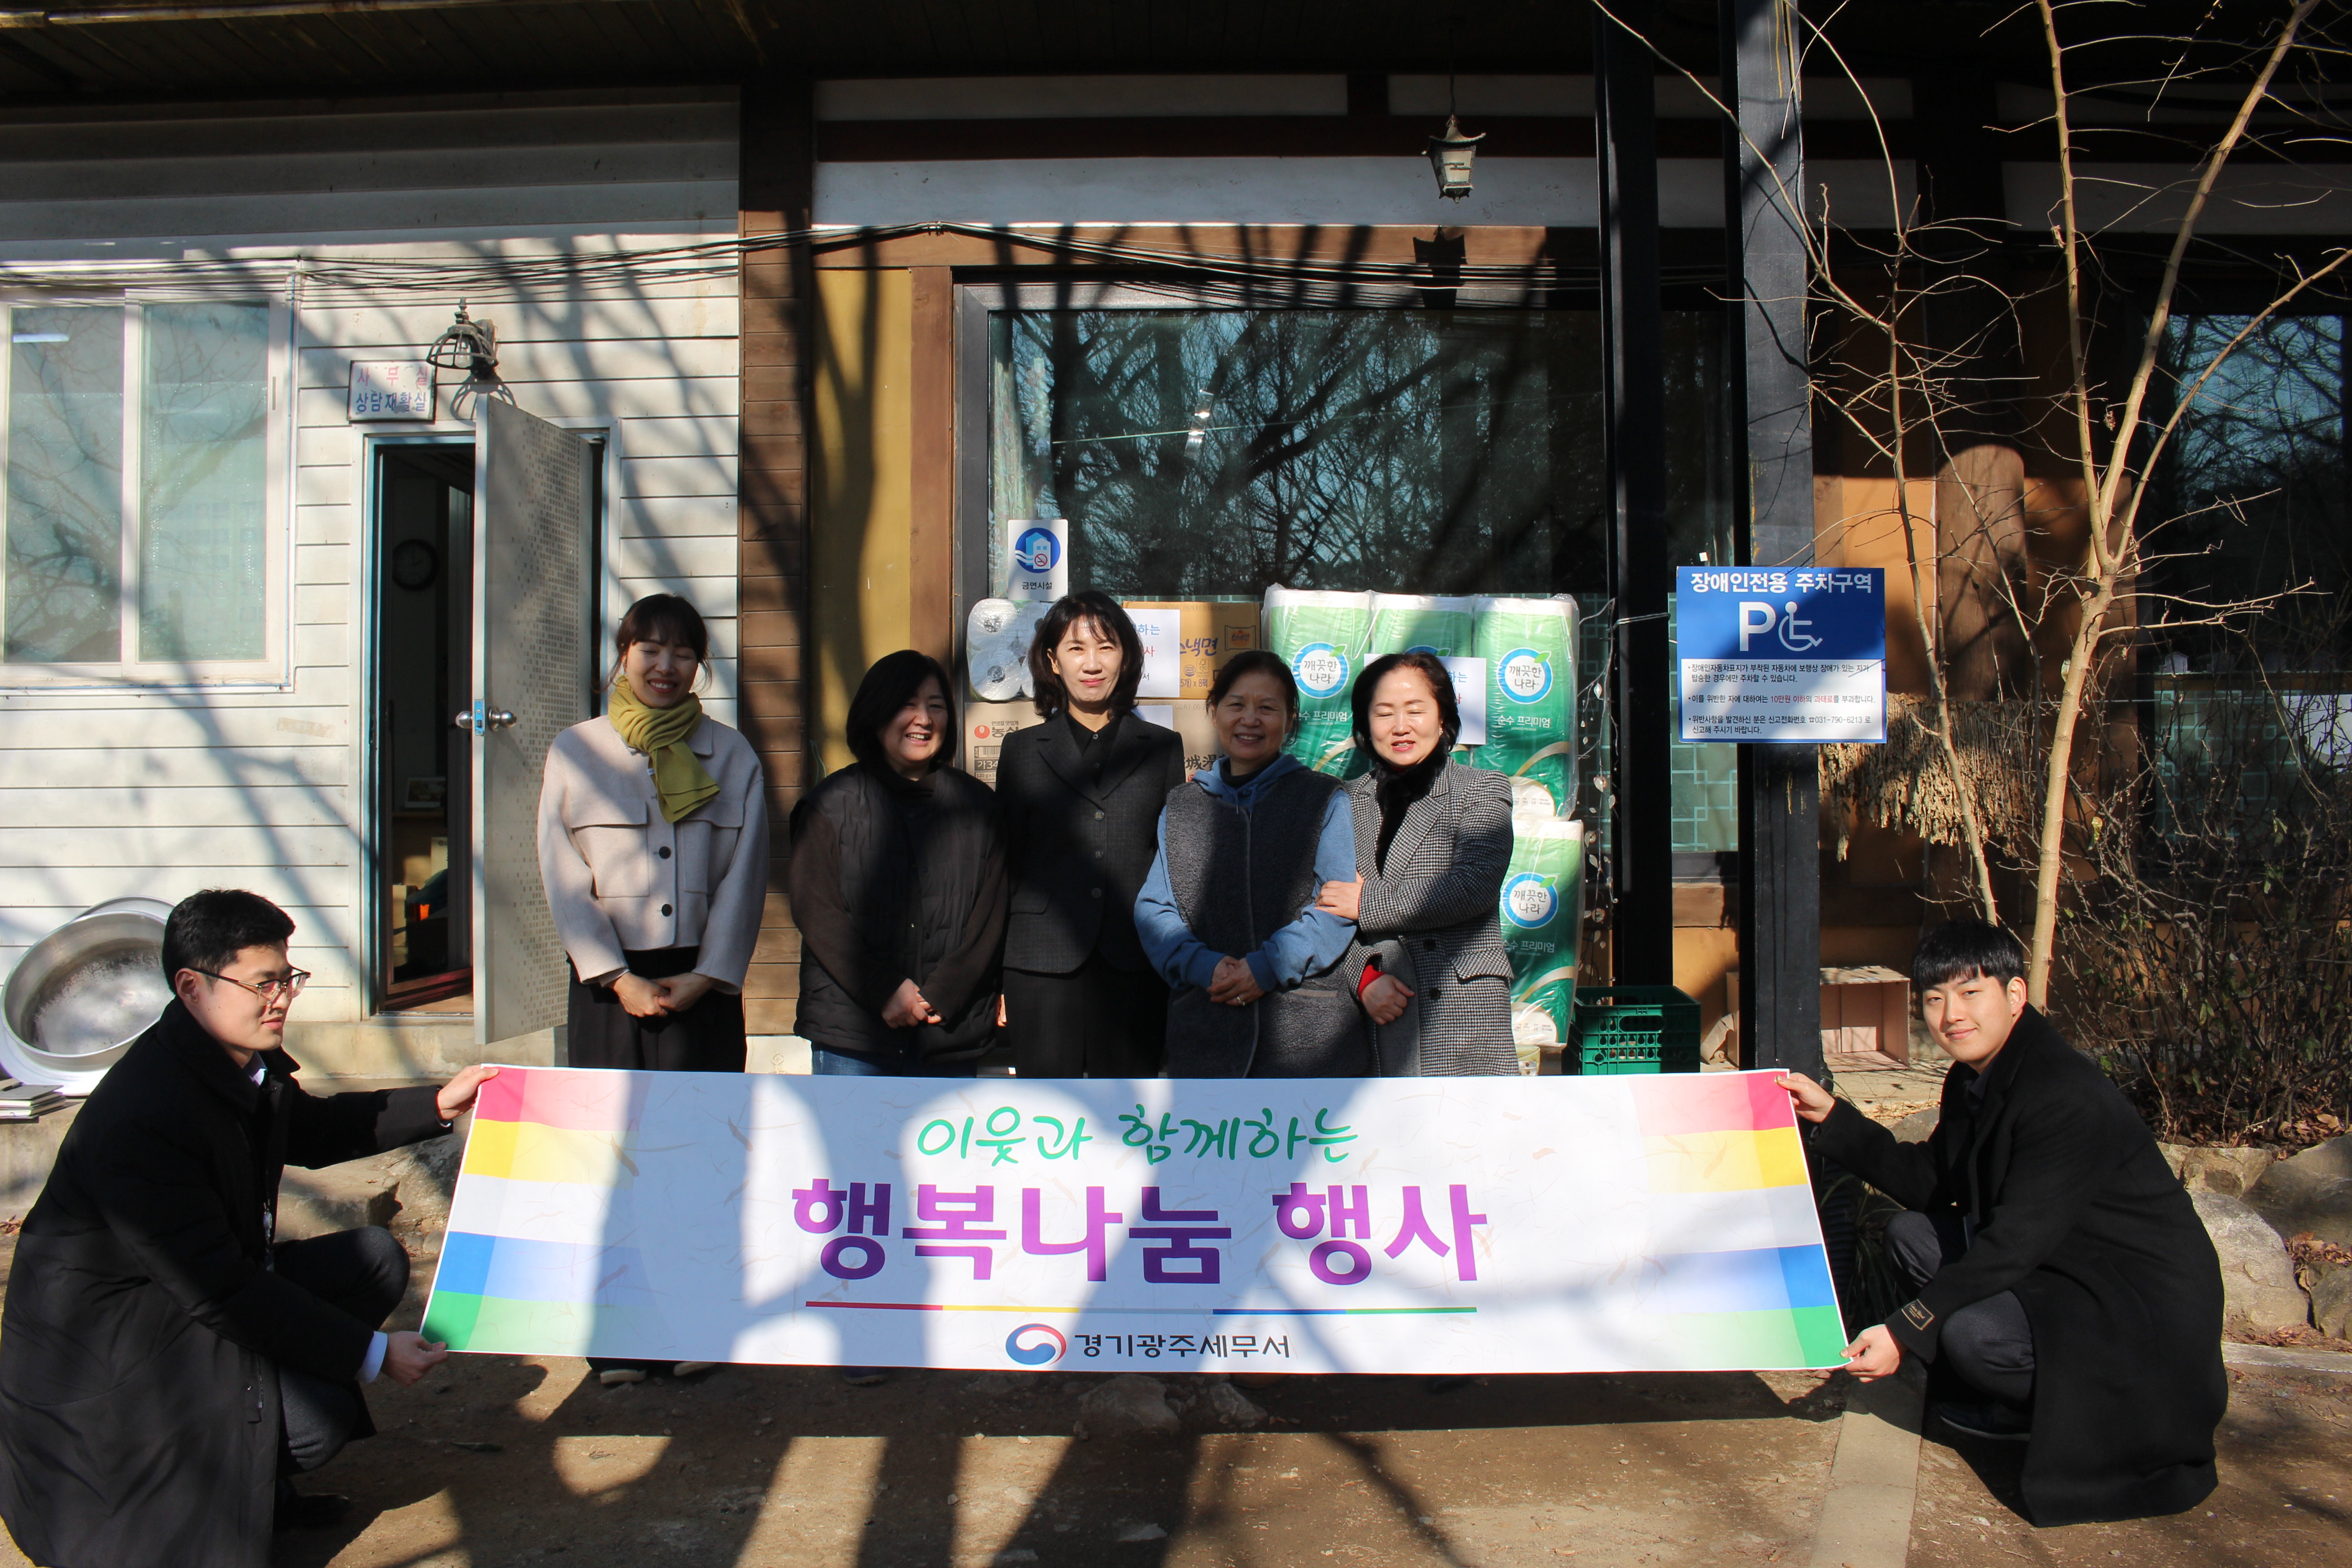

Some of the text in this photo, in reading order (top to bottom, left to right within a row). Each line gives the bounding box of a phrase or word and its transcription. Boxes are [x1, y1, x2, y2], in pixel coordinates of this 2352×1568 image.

[1690, 573, 1872, 593] 장애인전용 주차구역
[1739, 602, 1776, 652] P
[1304, 660, 1338, 671] 깨끗한
[1691, 664, 1748, 672] 장애인자동차표지가
[1750, 664, 1769, 672] 부착된
[1771, 664, 1797, 672] 자동차에
[1799, 664, 1818, 672] 보행상
[1820, 664, 1839, 672] 장애가
[1509, 665, 1542, 678] 깨끗한
[1310, 673, 1332, 684] 나라
[1691, 674, 1710, 682] 탑승한
[1713, 674, 1738, 682] 경우에만
[1740, 674, 1759, 682] 주차할
[1514, 679, 1536, 690] 나라
[1692, 695, 1876, 703] 이를 위반한 자에 대하여는 10만원 이하의 과태료를 부과합니다.
[1313, 711, 1348, 722] 프리미엄
[1498, 715, 1550, 728] 순수 프리미엄
[1692, 715, 1724, 724] 위반사항을
[1726, 715, 1751, 724] 발견하신
[1753, 715, 1766, 724] 분은
[1768, 715, 1806, 724] 신고전화번호
[1693, 726, 1762, 734] 신고해 주시기 바랍니다.
[1514, 890, 1547, 902] 깨끗한
[1519, 903, 1541, 914] 나라
[1521, 941, 1555, 953] 프리미엄
[917, 1104, 1360, 1166] 이웃과 함께하는
[792, 1178, 1488, 1285] 행복나눔 행사
[1075, 1334, 1290, 1357] 경기광주세무서
